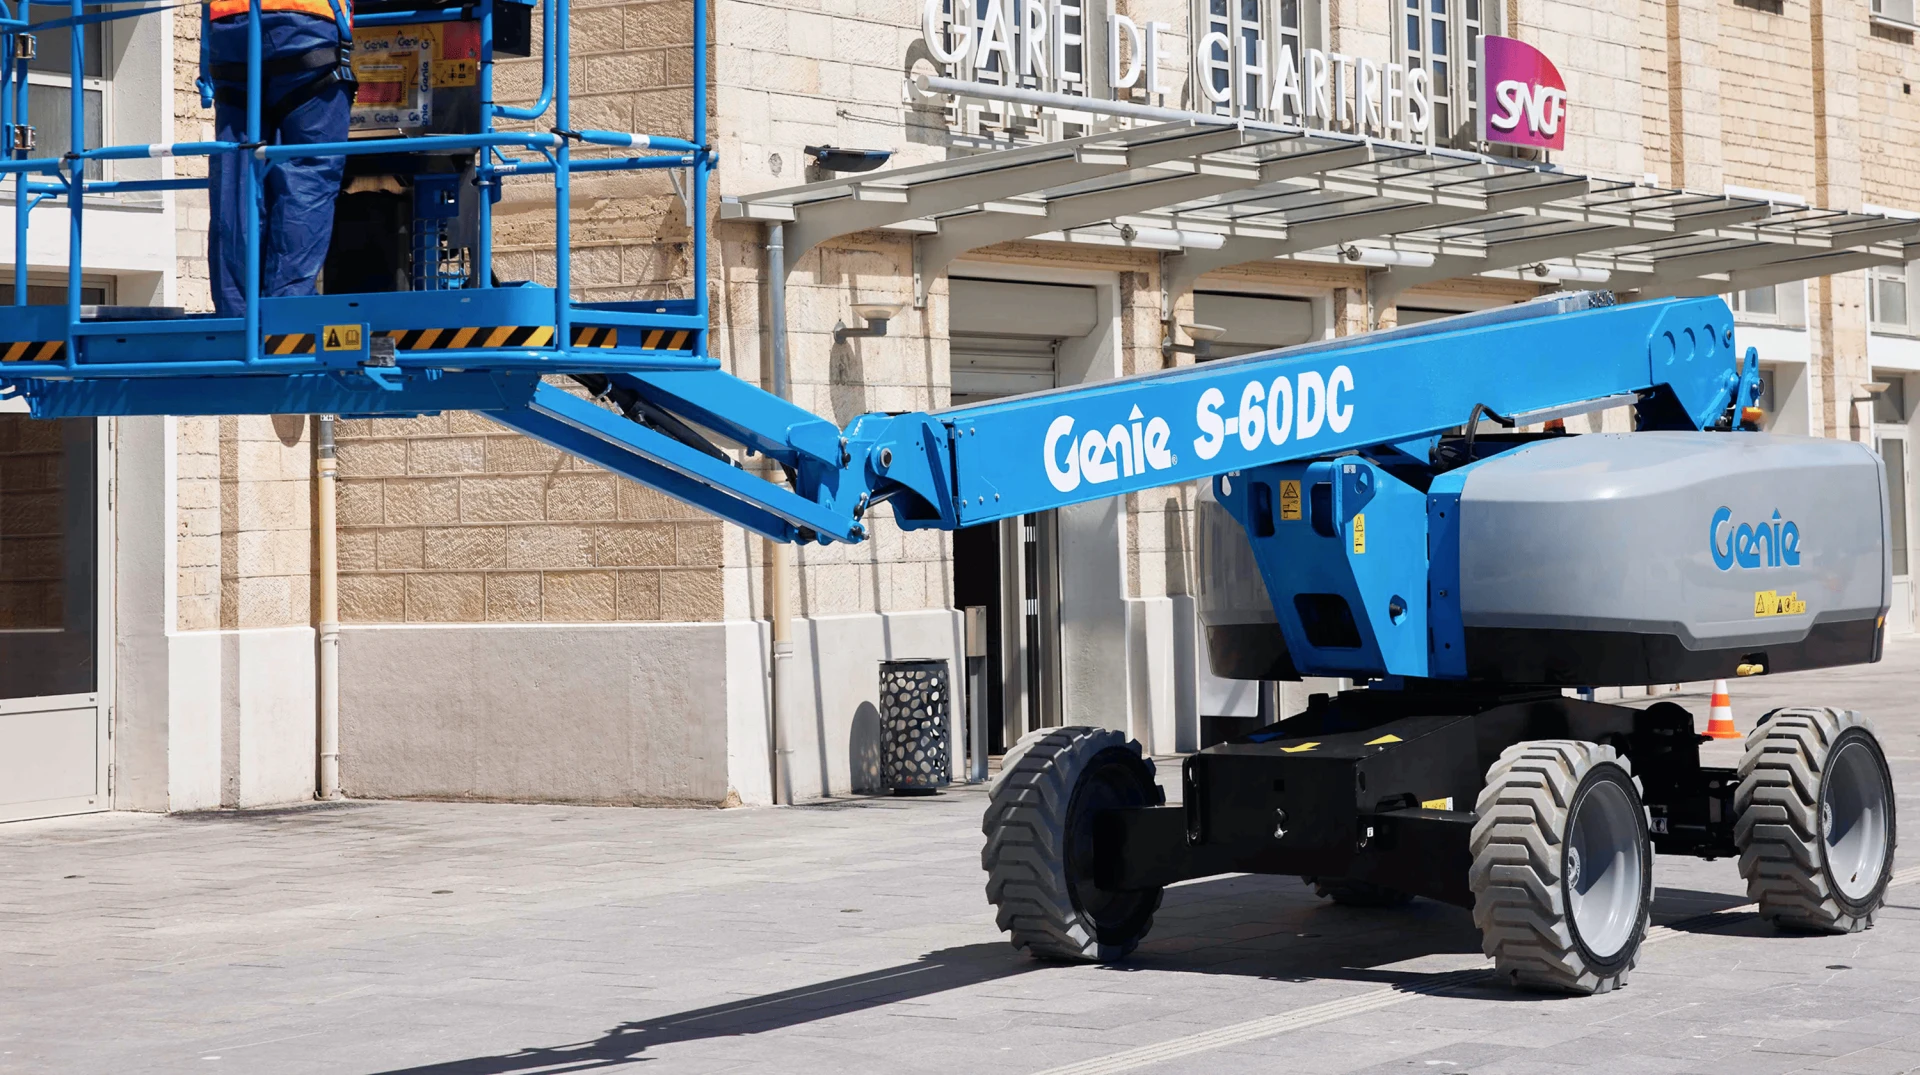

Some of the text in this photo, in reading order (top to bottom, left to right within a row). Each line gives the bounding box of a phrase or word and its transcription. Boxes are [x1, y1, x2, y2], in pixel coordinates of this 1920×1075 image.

[397, 36, 419, 48] Geni
[922, 0, 1430, 133] GARE DE CHARTRES
[1491, 80, 1567, 135] SNCF
[1044, 365, 1355, 492] Genie S-60DC
[1709, 505, 1801, 571] Genie
